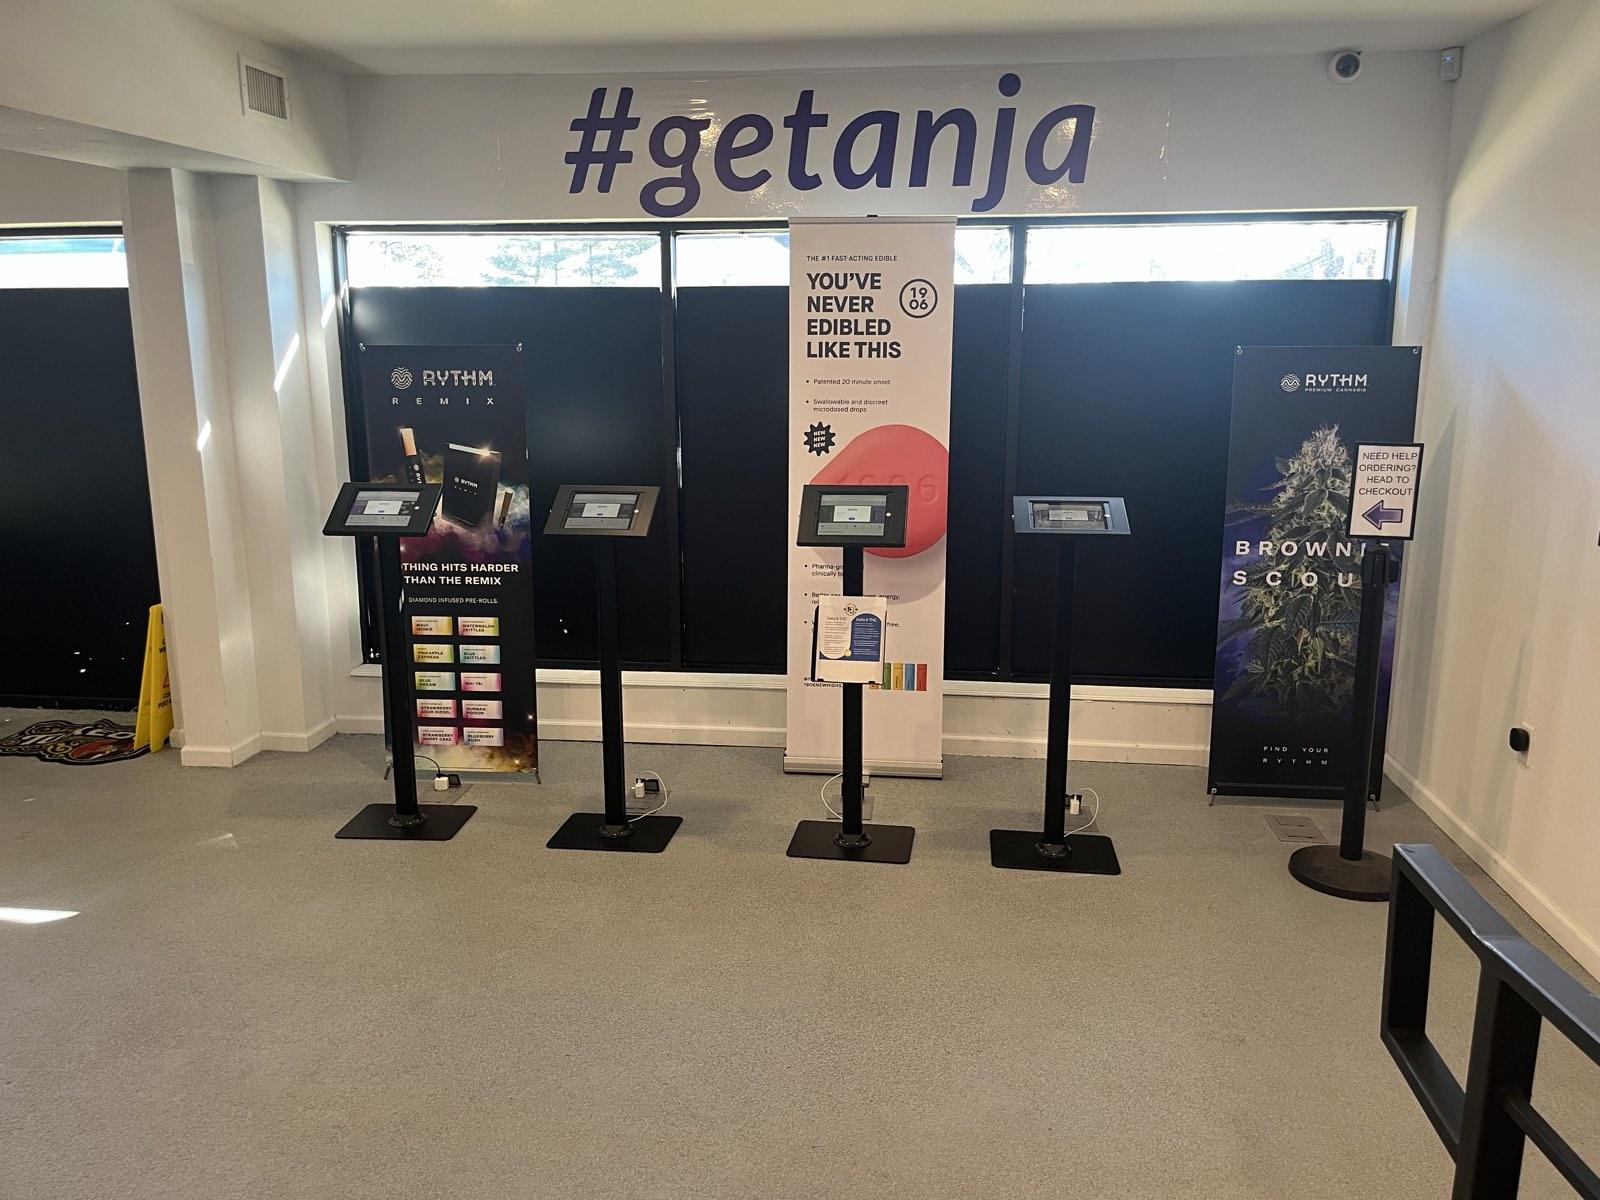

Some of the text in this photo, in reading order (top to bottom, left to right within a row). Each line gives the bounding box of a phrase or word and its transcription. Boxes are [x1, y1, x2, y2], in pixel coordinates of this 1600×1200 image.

[564, 72, 1096, 218] #getanja
[806, 272, 882, 290] YOU'VE
[910, 287, 928, 299] 19
[807, 296, 874, 312] NEVER
[807, 318, 891, 336] EDIBLED
[806, 342, 902, 358] LIKE THIS
[422, 370, 493, 386] RYTHM
[1305, 374, 1368, 387] RYTHM
[392, 397, 494, 405] REMIX
[850, 406, 867, 414] drops
[1362, 452, 1418, 461] NEED HELP
[1358, 464, 1417, 472] ORDERING?
[1366, 476, 1410, 484] HEAD TO
[1358, 488, 1413, 496] CHECKOUT
[1235, 540, 1390, 557] BROWNI
[400, 562, 519, 572] THING HITS HARDER
[404, 576, 502, 585] THAN THE REMIX
[1232, 571, 1353, 587] SCOU
